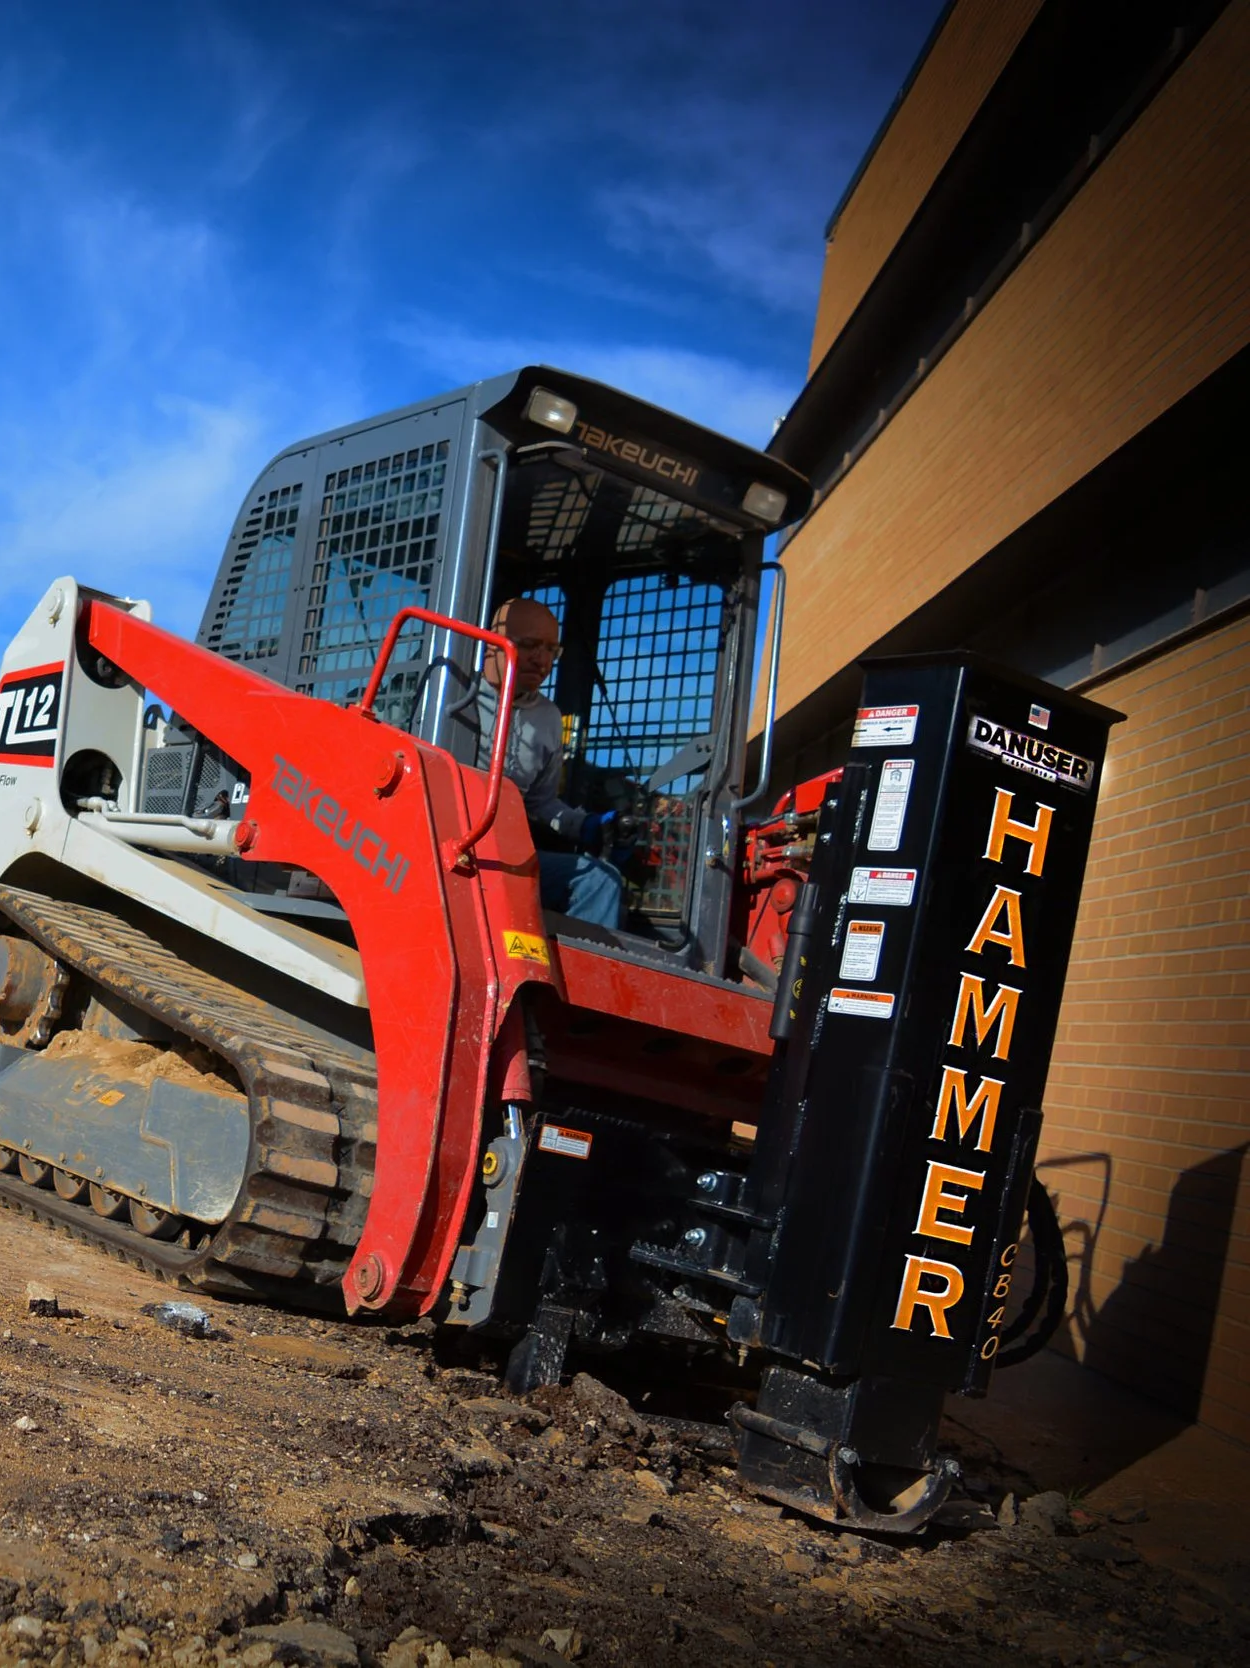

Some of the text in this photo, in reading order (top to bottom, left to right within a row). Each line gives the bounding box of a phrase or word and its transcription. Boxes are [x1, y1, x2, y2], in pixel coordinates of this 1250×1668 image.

[875, 708, 908, 717] DANGER
[975, 719, 1088, 781] DANUSER
[851, 992, 879, 1001] WARNING
[890, 786, 1056, 1340] HAMMER
[980, 1243, 1018, 1360] CB40
